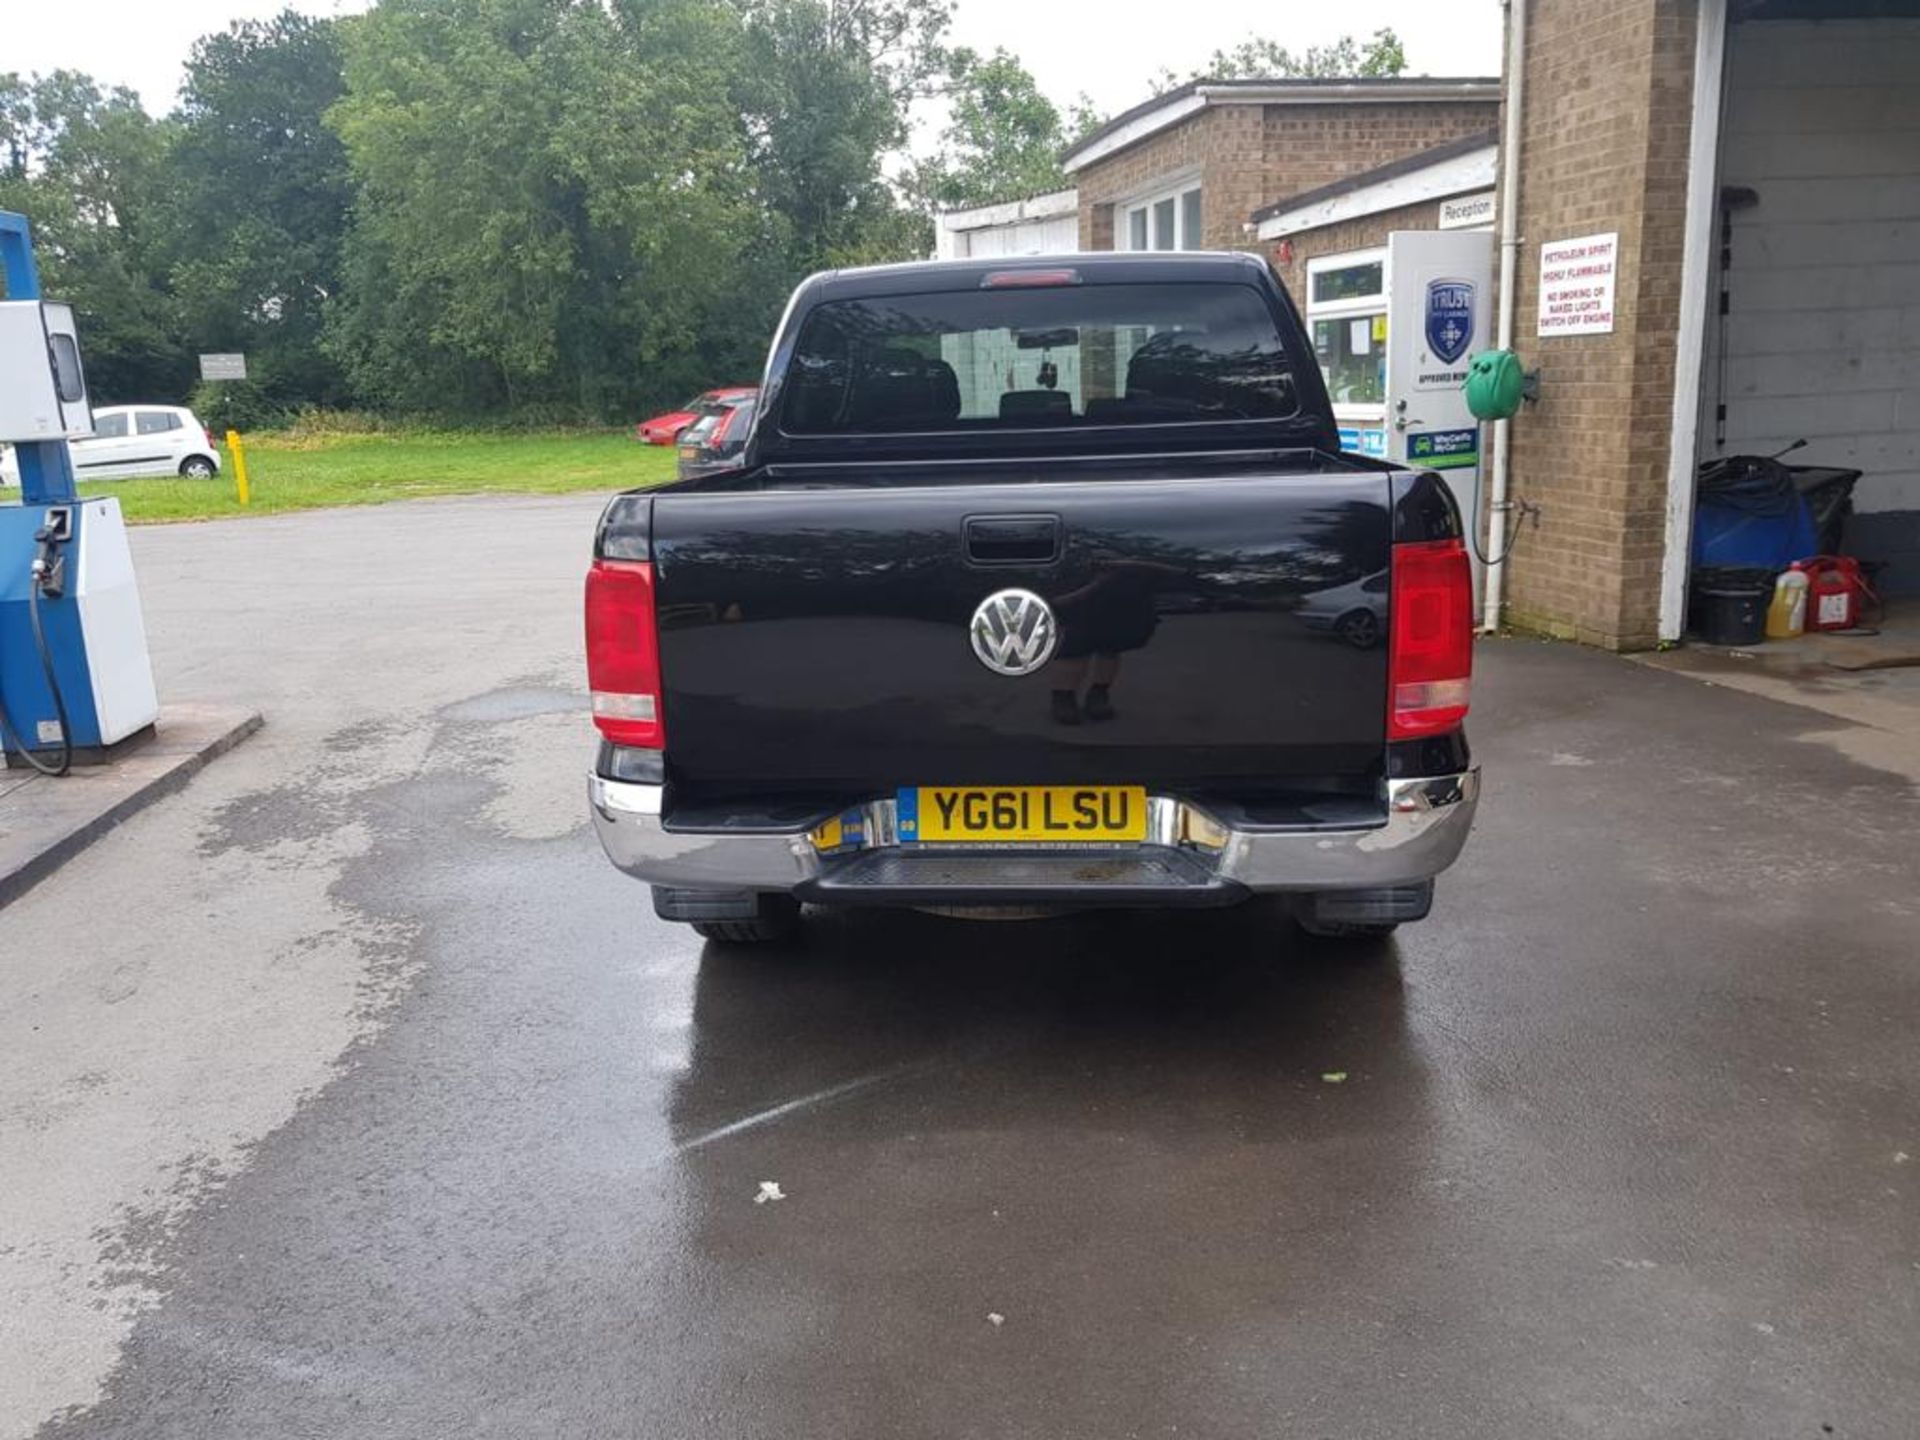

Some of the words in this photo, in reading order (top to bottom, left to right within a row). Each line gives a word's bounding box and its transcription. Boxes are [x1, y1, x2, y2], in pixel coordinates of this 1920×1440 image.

[1445, 201, 1490, 219] Reception
[1545, 248, 1586, 263] PETROLEUM
[1588, 243, 1612, 257] SPIRIT
[1567, 263, 1611, 279] FLAMMABLE
[1431, 289, 1470, 309] TRUST
[1547, 292, 1557, 302] NO
[1559, 288, 1592, 301] SMOKING
[1594, 286, 1605, 297] OR
[1549, 303, 1573, 314] NAKED
[1574, 300, 1600, 312] LIGHTS
[1541, 316, 1566, 327] SWITCH
[1567, 314, 1582, 326] OFF
[1583, 312, 1611, 324] ENGINE
[934, 791, 1029, 831] YG61
[1043, 791, 1128, 831] LSU
